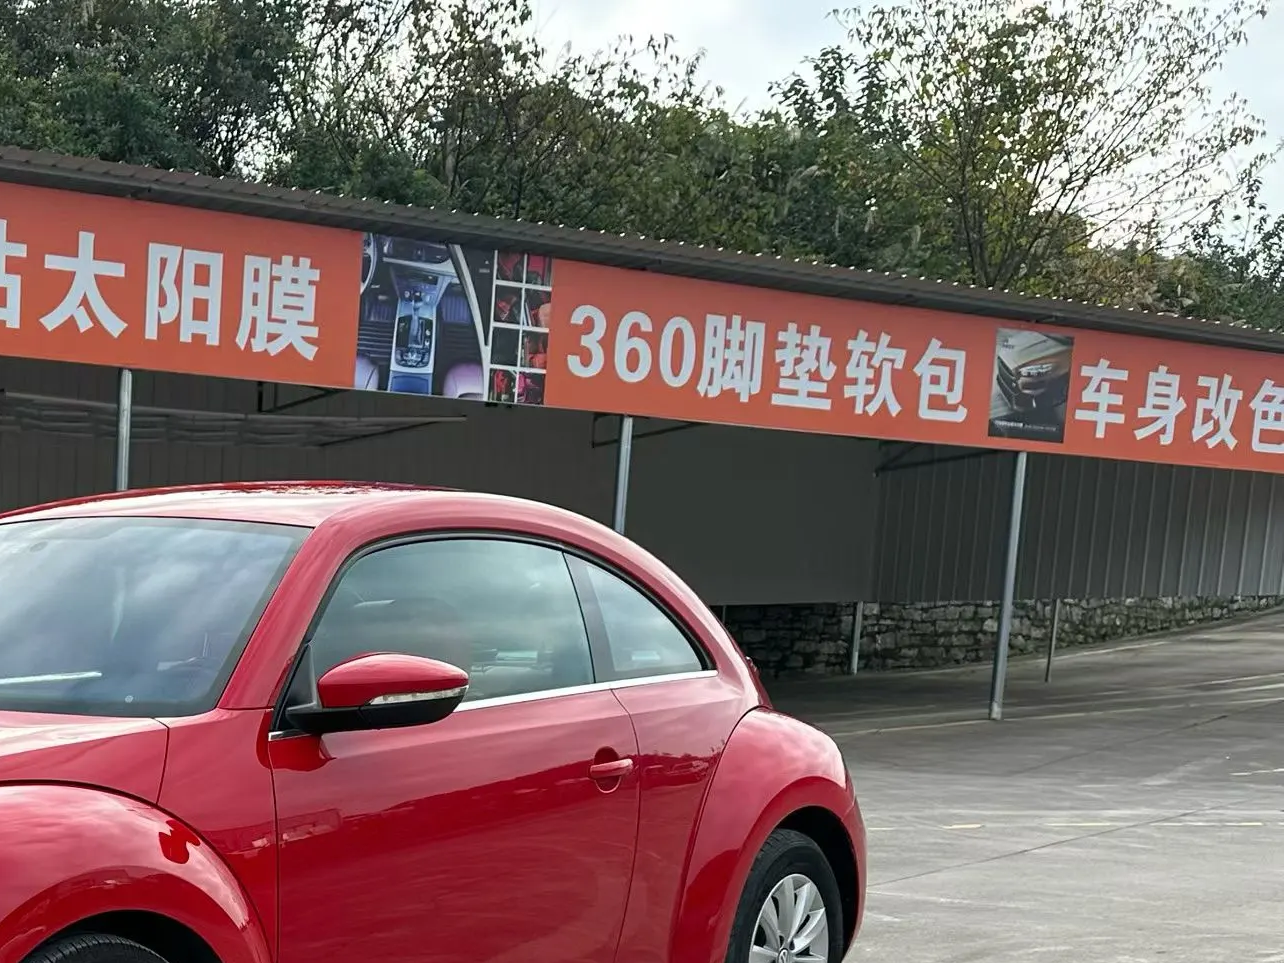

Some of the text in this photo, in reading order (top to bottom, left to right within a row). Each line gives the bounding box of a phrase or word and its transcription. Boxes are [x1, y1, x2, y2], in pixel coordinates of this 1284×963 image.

[567, 304, 968, 423] 360脚垫软包
[1074, 358, 1284, 454] 车身改色
